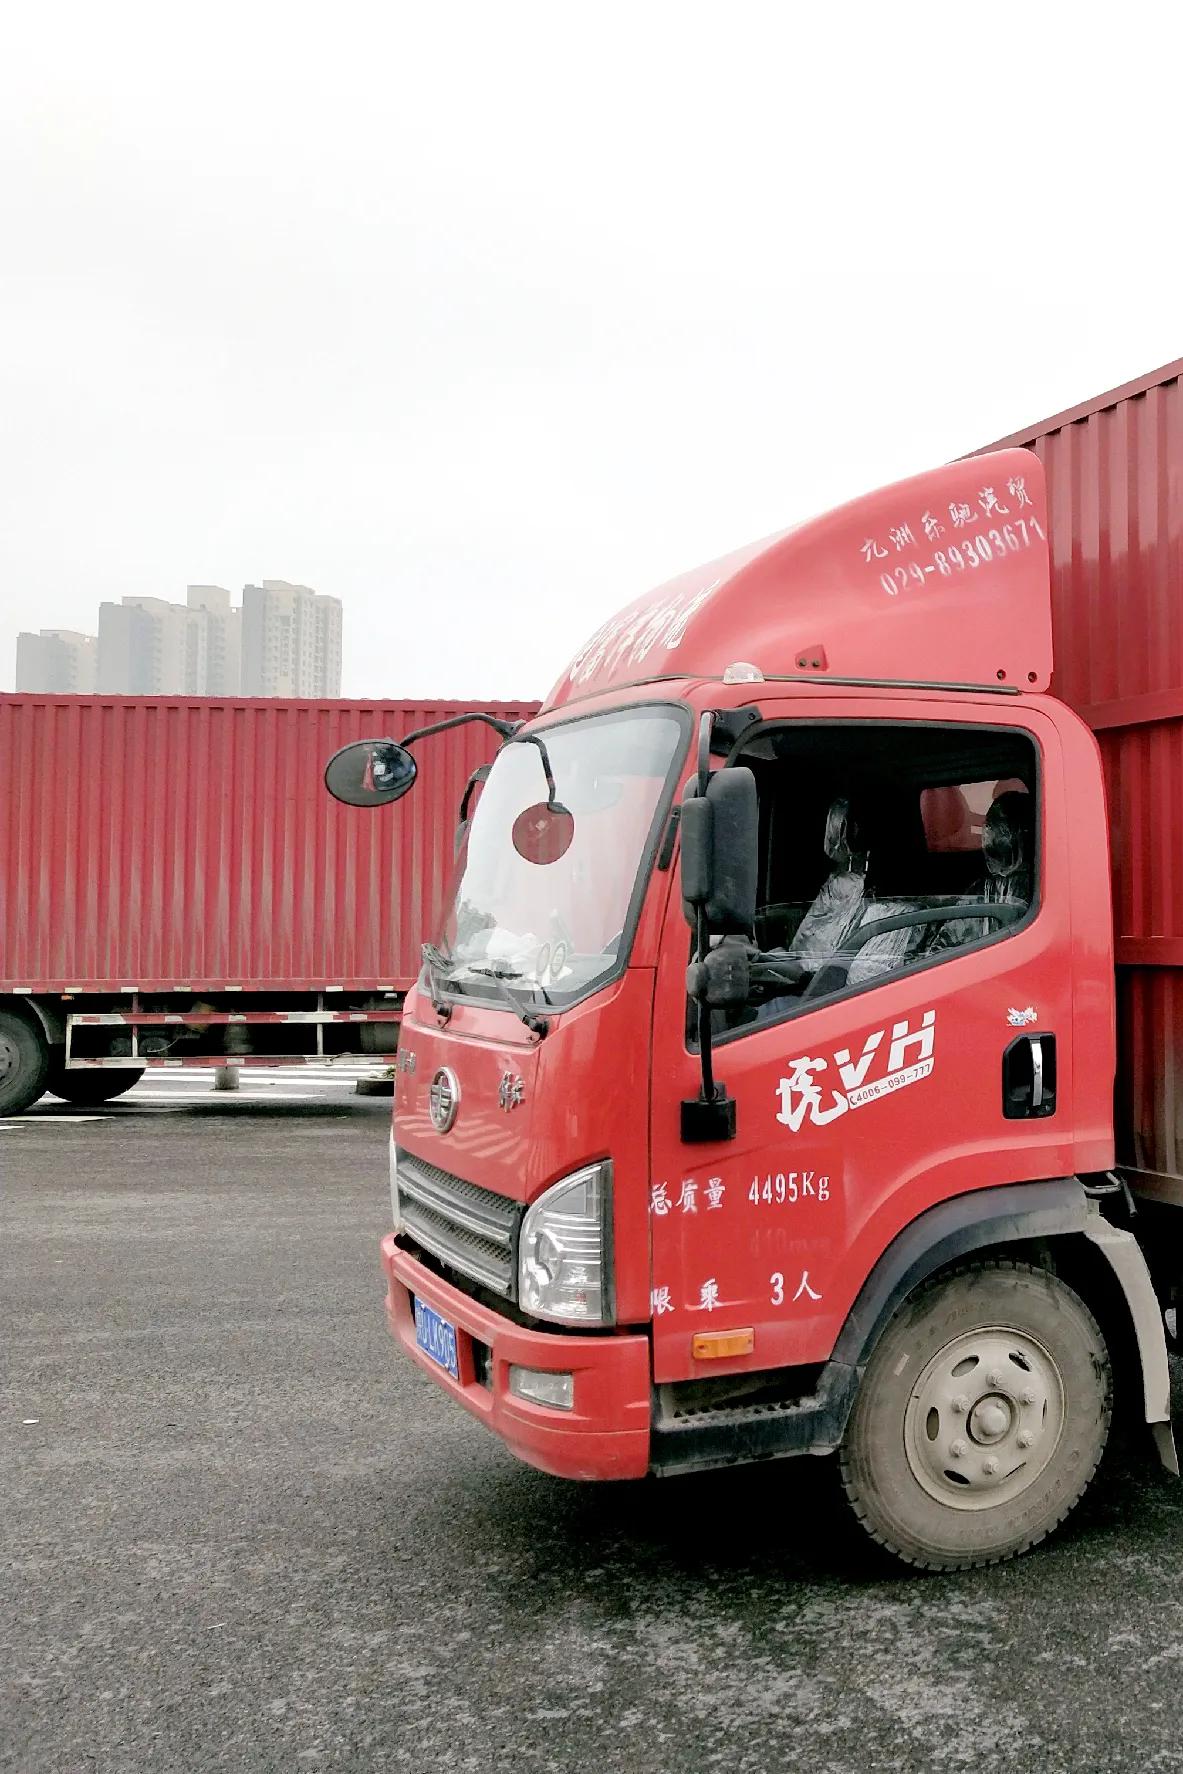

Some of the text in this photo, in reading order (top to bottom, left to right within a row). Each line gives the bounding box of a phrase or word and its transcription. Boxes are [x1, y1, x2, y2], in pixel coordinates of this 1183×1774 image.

[856, 1063, 931, 1102] 4006-099-777
[648, 1177, 726, 1215] 总质量
